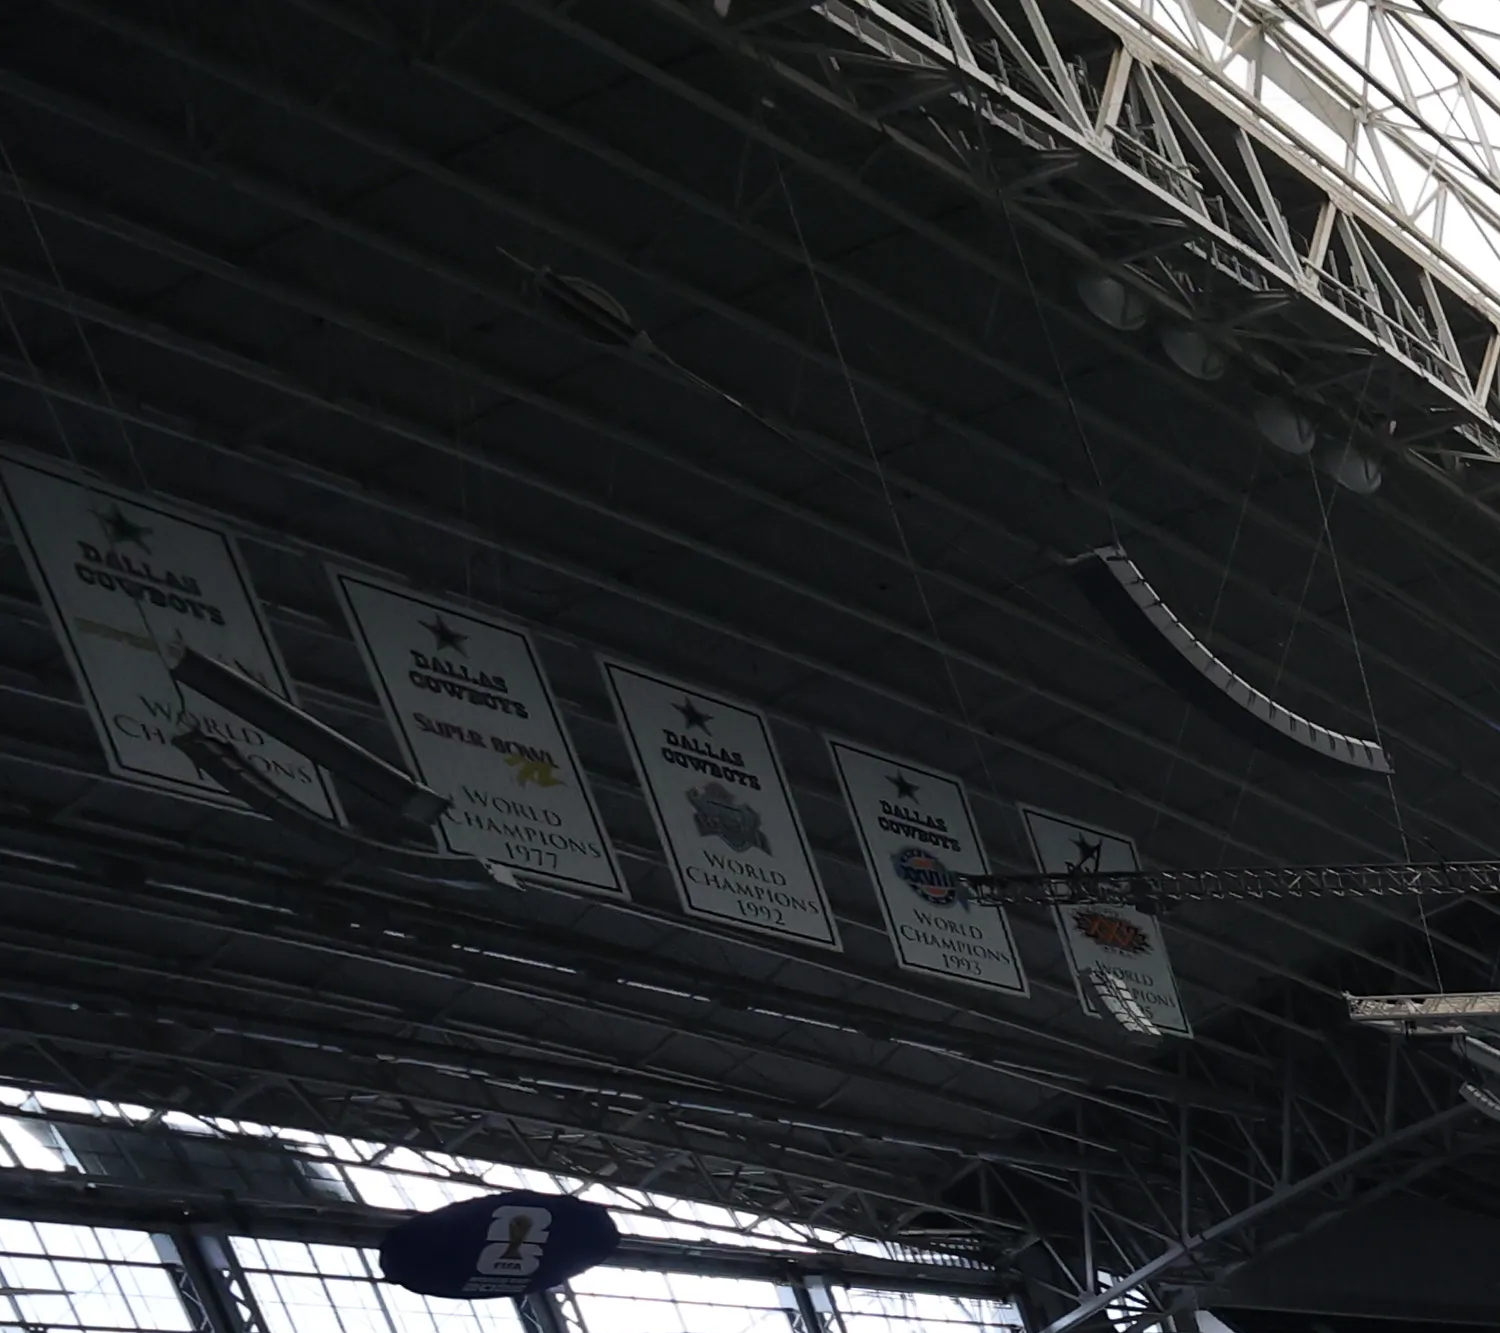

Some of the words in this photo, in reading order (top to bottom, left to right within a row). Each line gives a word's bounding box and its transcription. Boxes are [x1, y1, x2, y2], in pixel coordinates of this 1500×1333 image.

[410, 650, 507, 694] DALLAS
[409, 671, 527, 718] COWBOYS
[413, 712, 485, 748] SUPER
[491, 736, 559, 768] BOWL
[664, 729, 744, 767] DALLAS
[662, 748, 760, 790] COWBOYS
[462, 786, 562, 827] WORLD
[879, 800, 948, 833] DALLAS
[445, 806, 600, 859] CHAMPIONS
[878, 817, 961, 852] COWBOYS
[504, 842, 558, 869] 1977
[703, 850, 786, 888] WORLD
[686, 866, 819, 916] CHAMPIONS
[737, 899, 785, 926] 1992
[913, 909, 983, 940] WORLD
[900, 925, 1011, 965] CHAMPIONS
[942, 954, 982, 976] 1993
